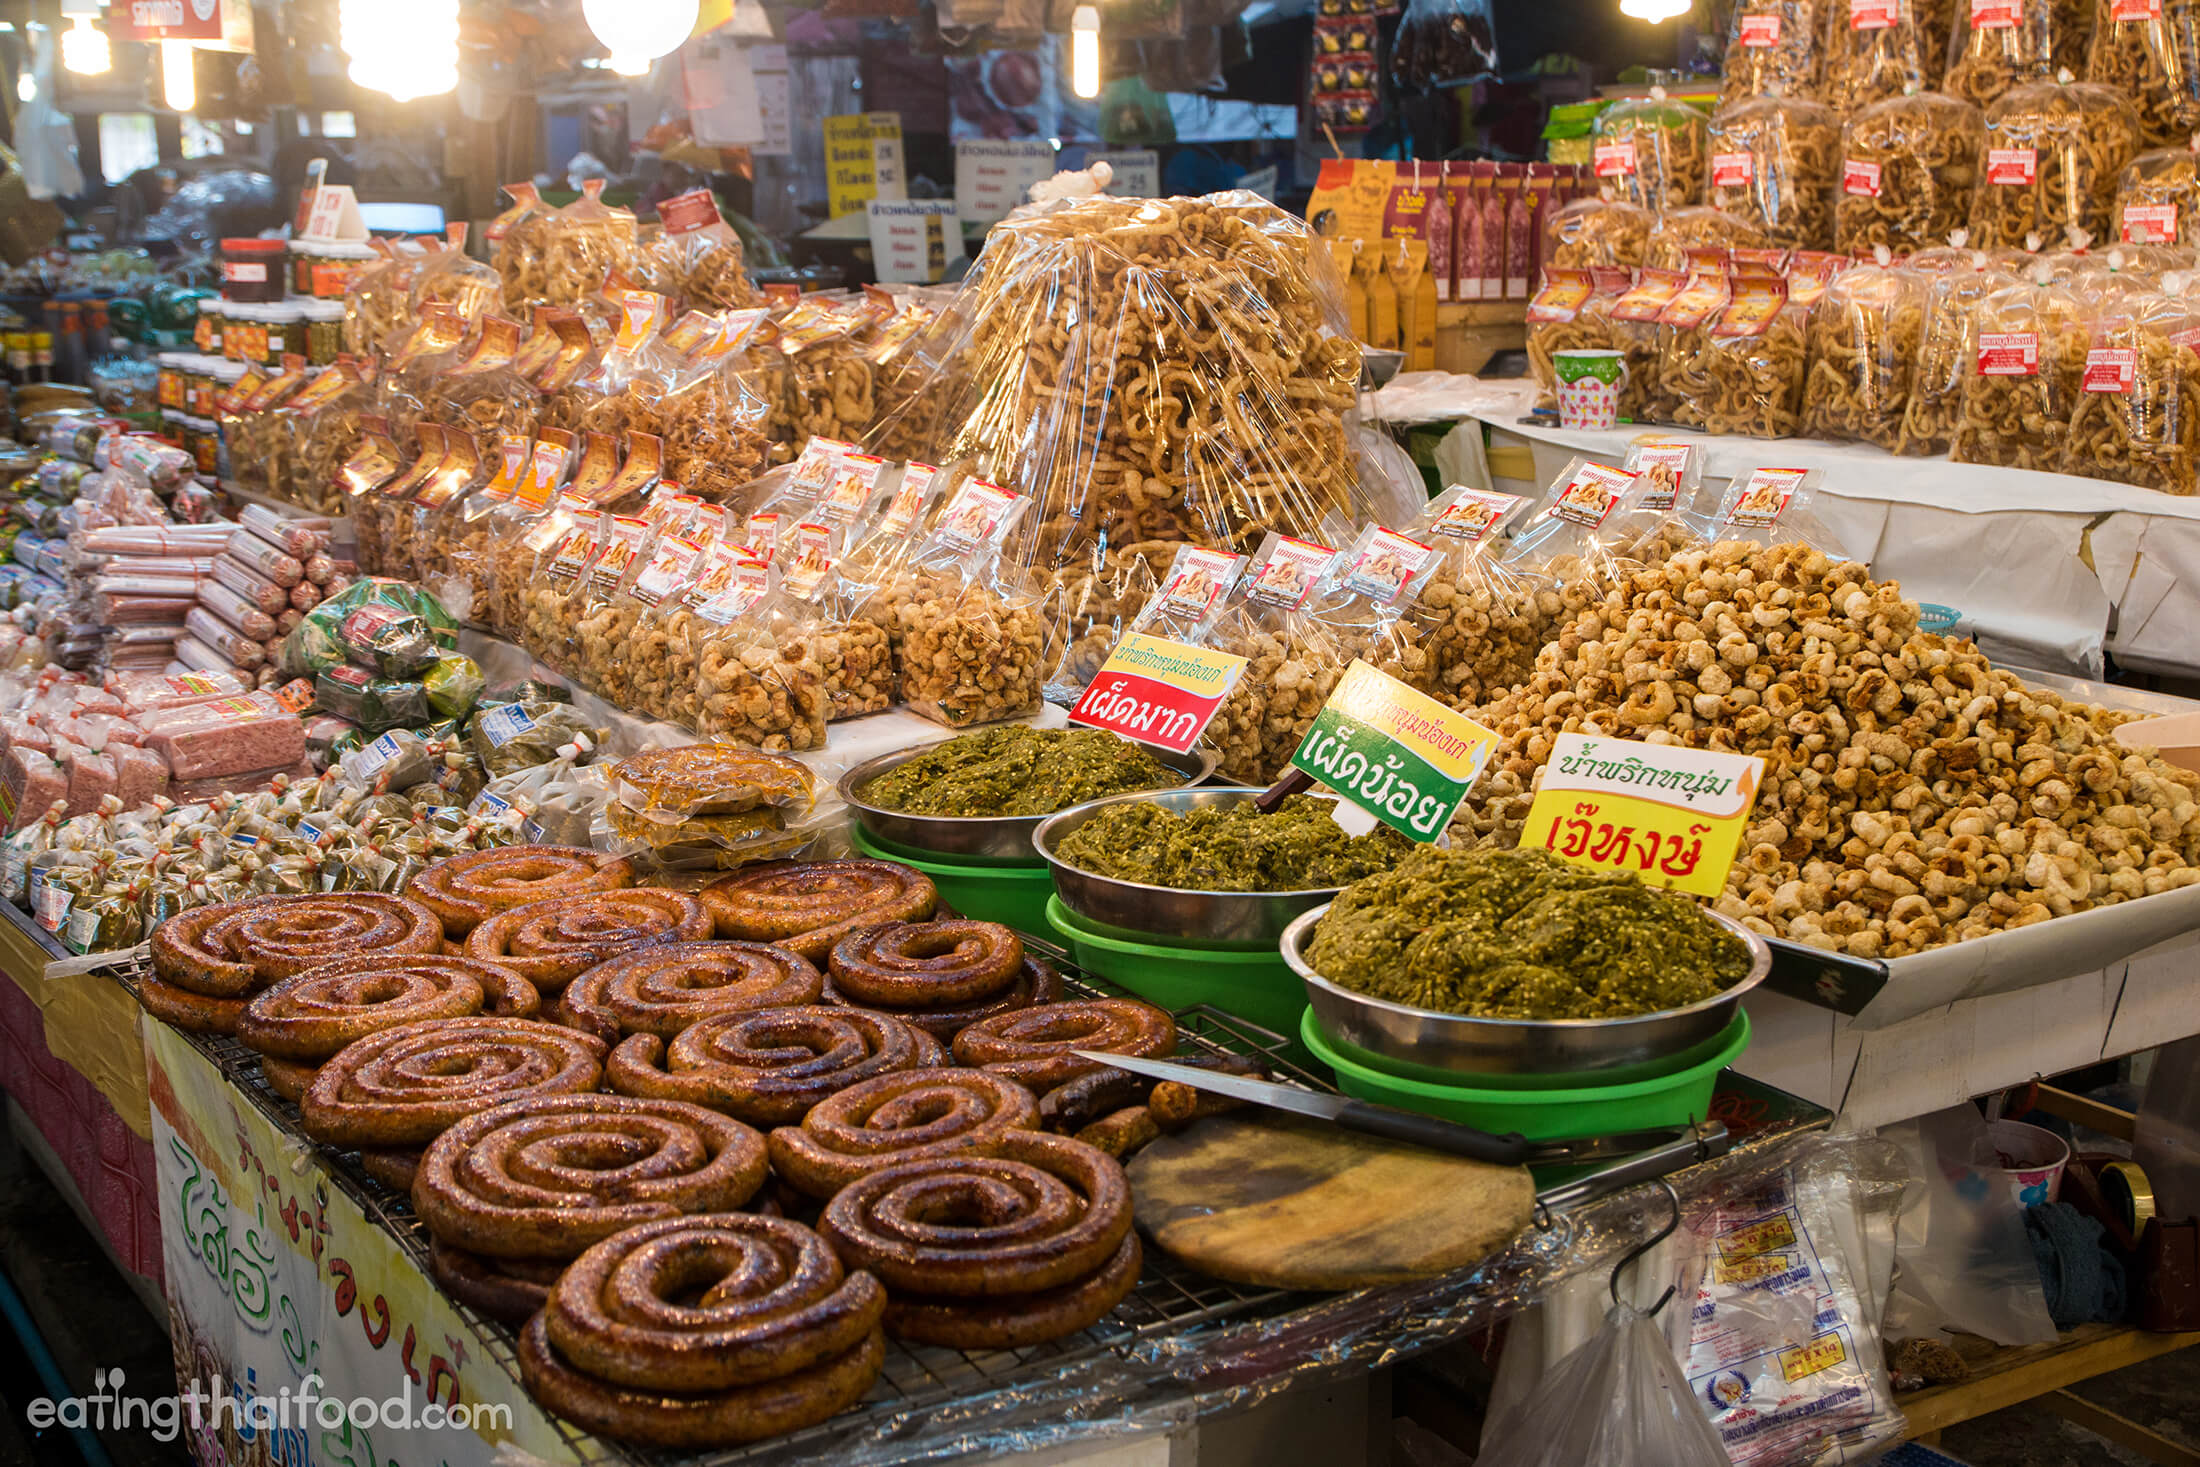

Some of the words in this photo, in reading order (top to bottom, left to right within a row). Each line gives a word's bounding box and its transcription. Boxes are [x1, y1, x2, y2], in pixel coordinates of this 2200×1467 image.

[1081, 680, 1198, 742] เผ็ดมาก
[1302, 725, 1448, 834] เผ็ดน้อย
[1559, 742, 1733, 802] น้ำพริกหนุ่ม
[1545, 801, 1712, 877] เจ๊หงษ์
